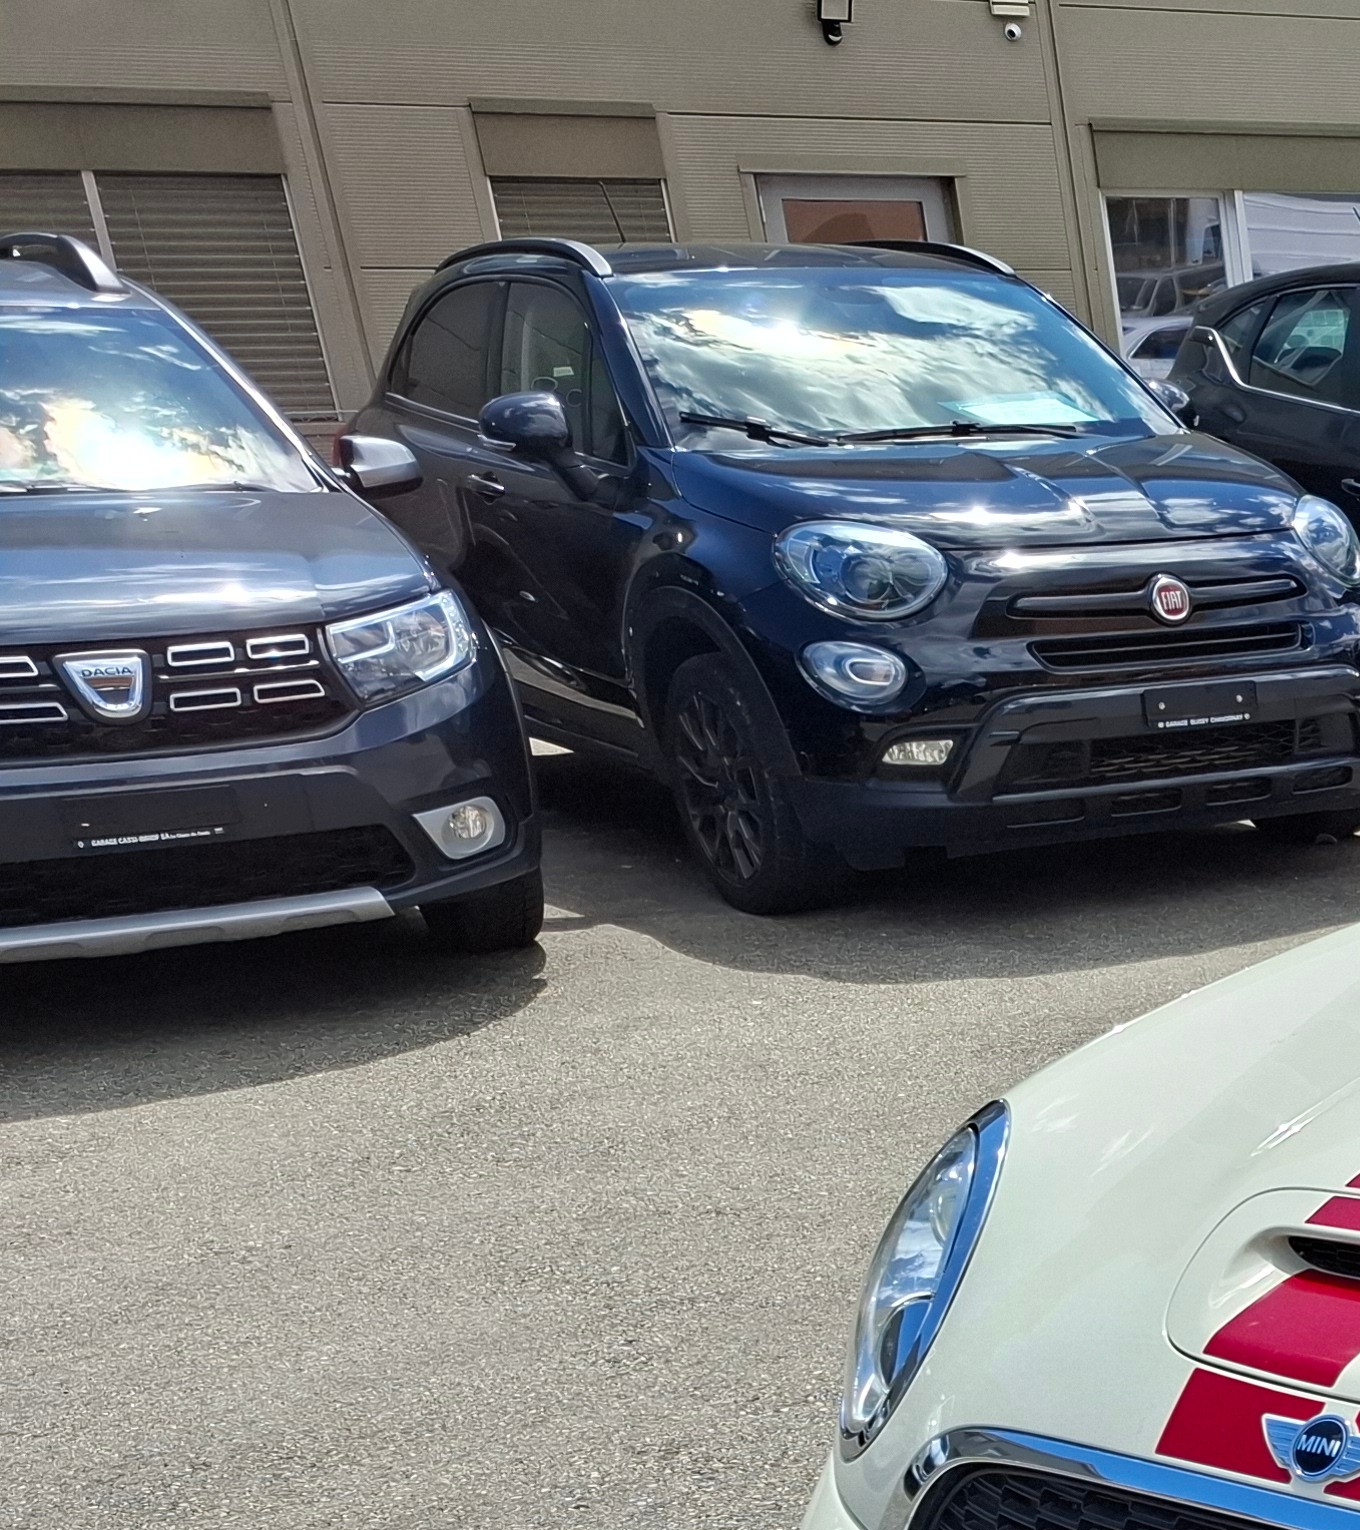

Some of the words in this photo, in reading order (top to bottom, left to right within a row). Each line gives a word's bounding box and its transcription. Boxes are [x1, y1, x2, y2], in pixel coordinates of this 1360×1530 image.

[1161, 590, 1182, 610] FIAT
[81, 666, 133, 678] DACIA
[1297, 1434, 1341, 1457] MINI
